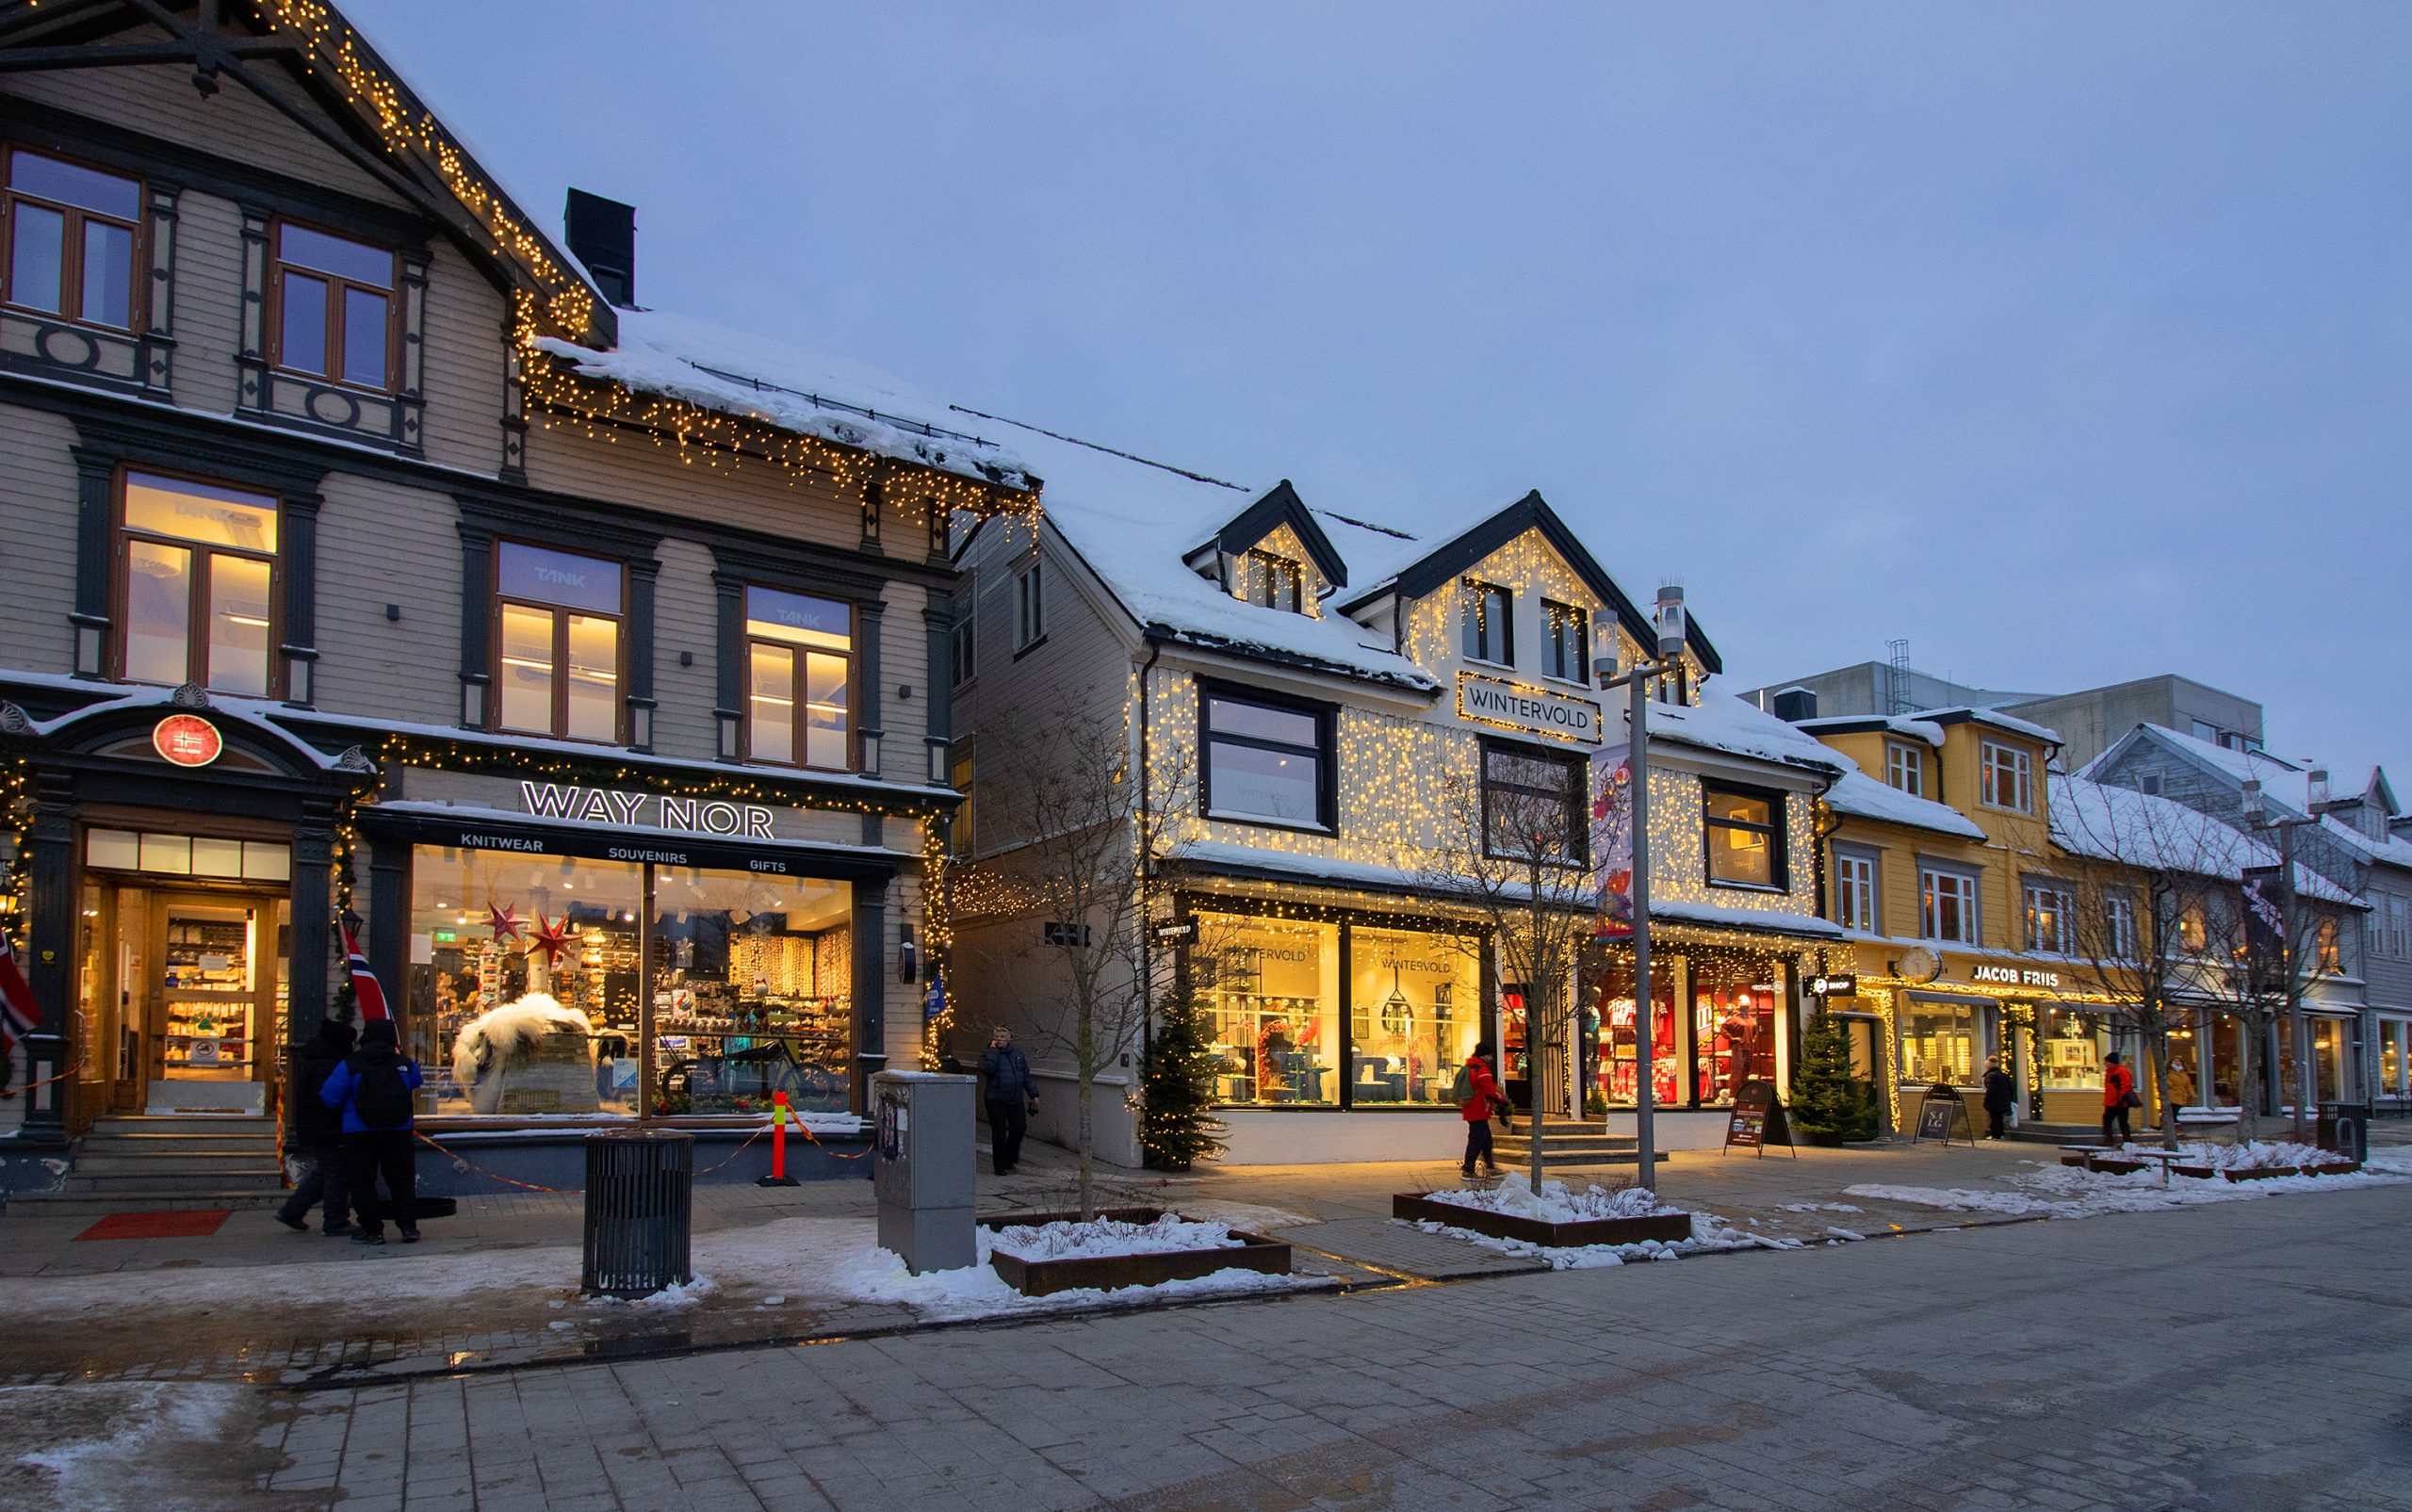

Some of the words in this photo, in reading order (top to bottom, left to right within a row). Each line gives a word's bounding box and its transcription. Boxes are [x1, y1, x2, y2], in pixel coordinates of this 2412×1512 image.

[535, 567, 585, 588] TANK
[776, 609, 820, 627] TANK
[1469, 688, 1588, 728] WINTERVOLD
[521, 781, 647, 825] WAY
[660, 796, 774, 839] NOR
[461, 834, 543, 852] KNITWEAR
[609, 848, 687, 864] SOUVENIRS
[750, 859, 786, 872] GIFTS
[1381, 958, 1451, 973] WINTERVOLD
[1974, 966, 2018, 983] JACOB
[2023, 970, 2059, 986] FRIIS
